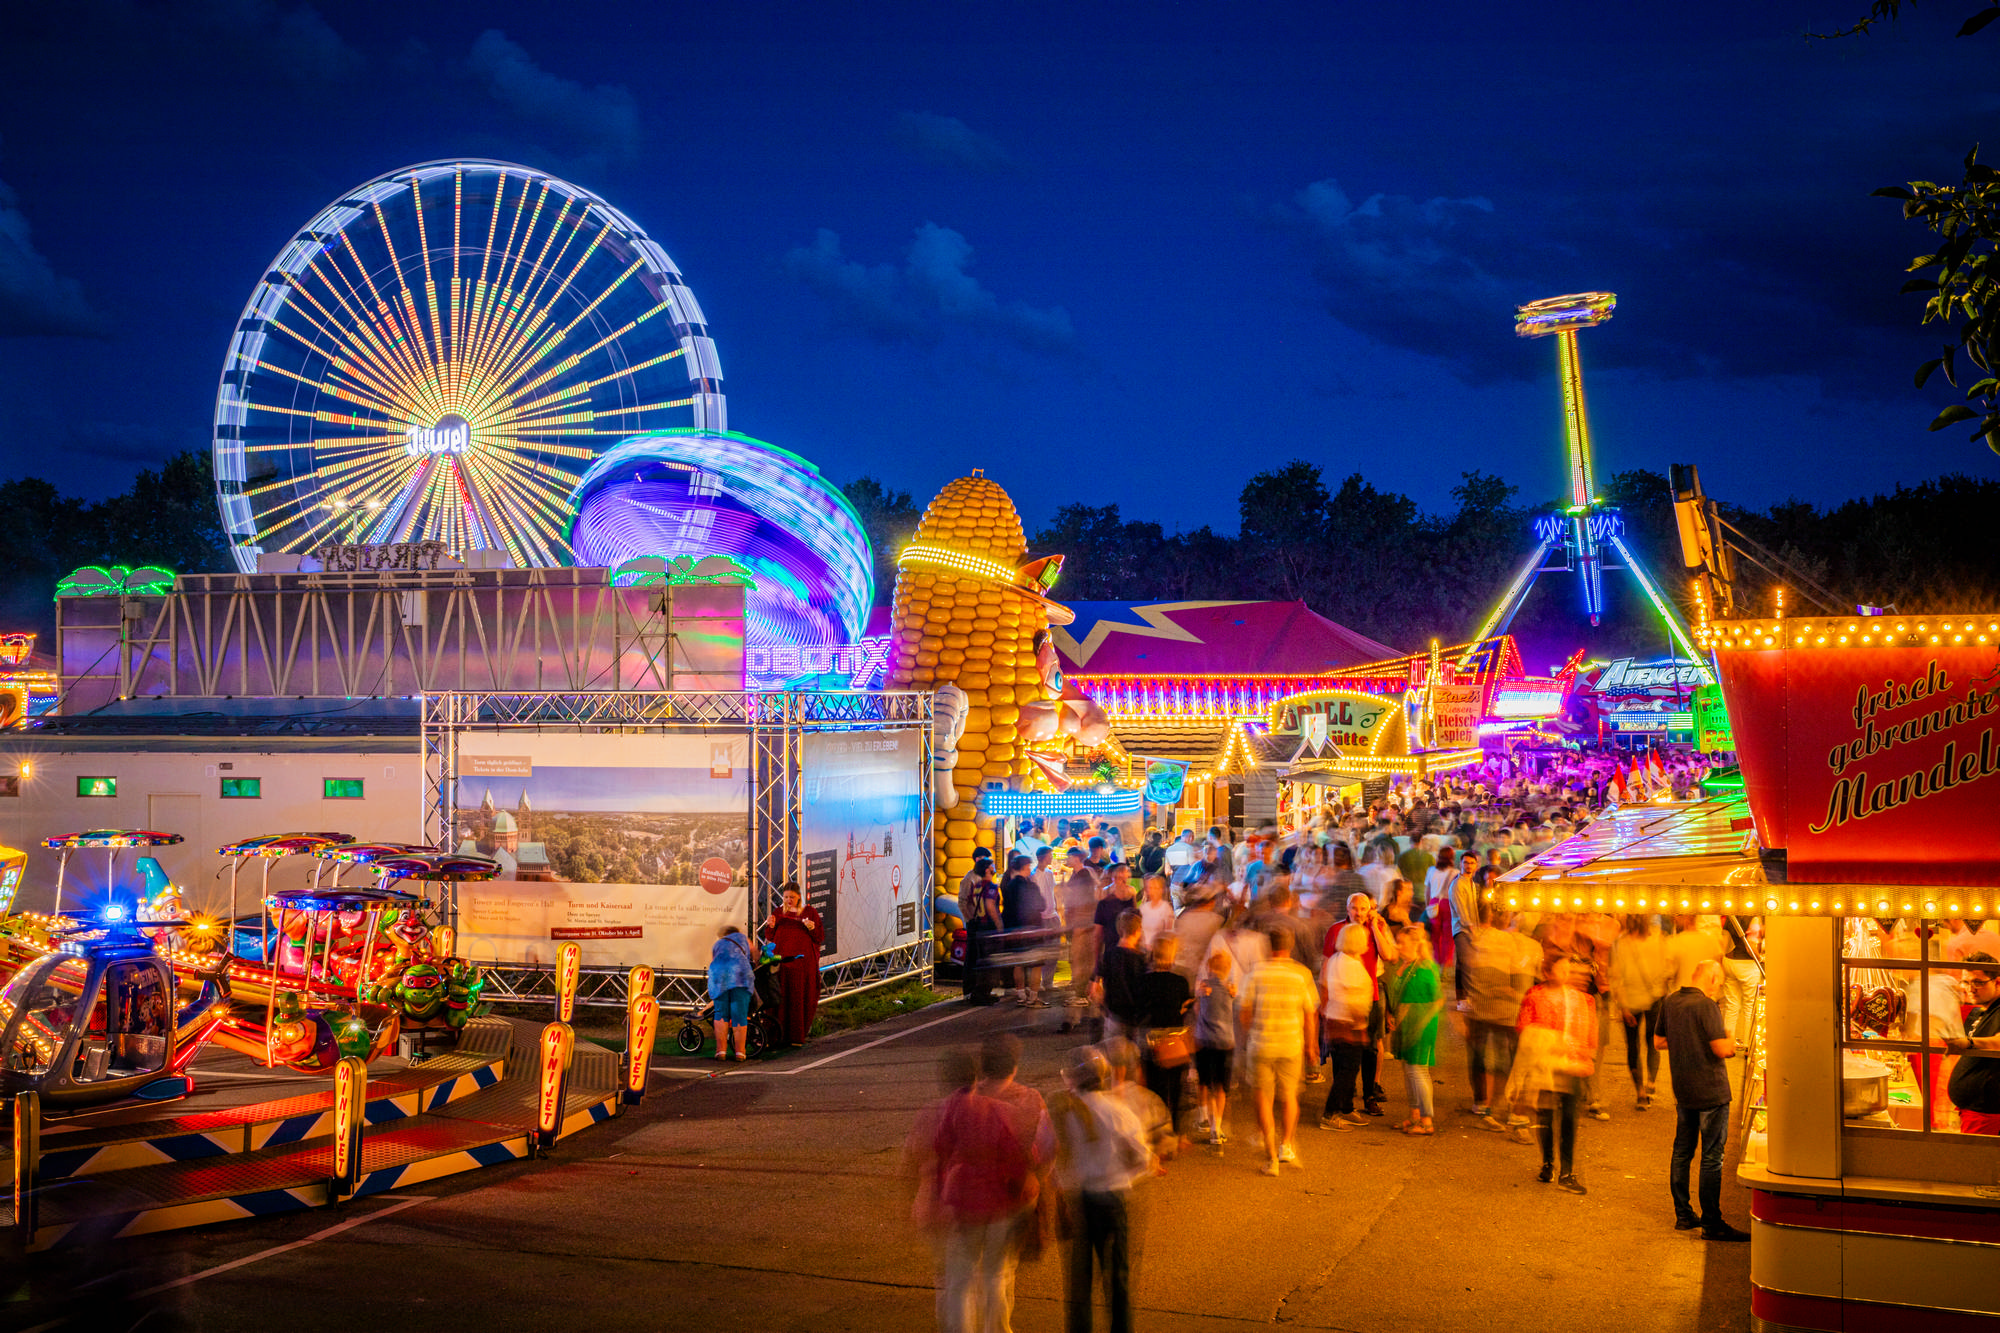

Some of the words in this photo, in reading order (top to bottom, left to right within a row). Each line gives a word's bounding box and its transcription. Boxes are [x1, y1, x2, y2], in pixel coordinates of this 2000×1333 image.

[745, 636, 893, 690] OBOTIX
[1853, 658, 1954, 729] frisch
[1331, 730, 1369, 746] ütte
[1437, 714, 1477, 727] Fleisch
[1828, 688, 1999, 776] gebrannte
[1808, 728, 2000, 834] Mandel
[568, 900, 585, 908] Turm
[586, 901, 599, 909] und
[600, 901, 633, 910] Kaisersaal
[563, 947, 577, 1019] MINIJET
[544, 1030, 561, 1125] MINIJET
[632, 1001, 652, 1086] MINIJET
[338, 1066, 350, 1172] MINIJET
